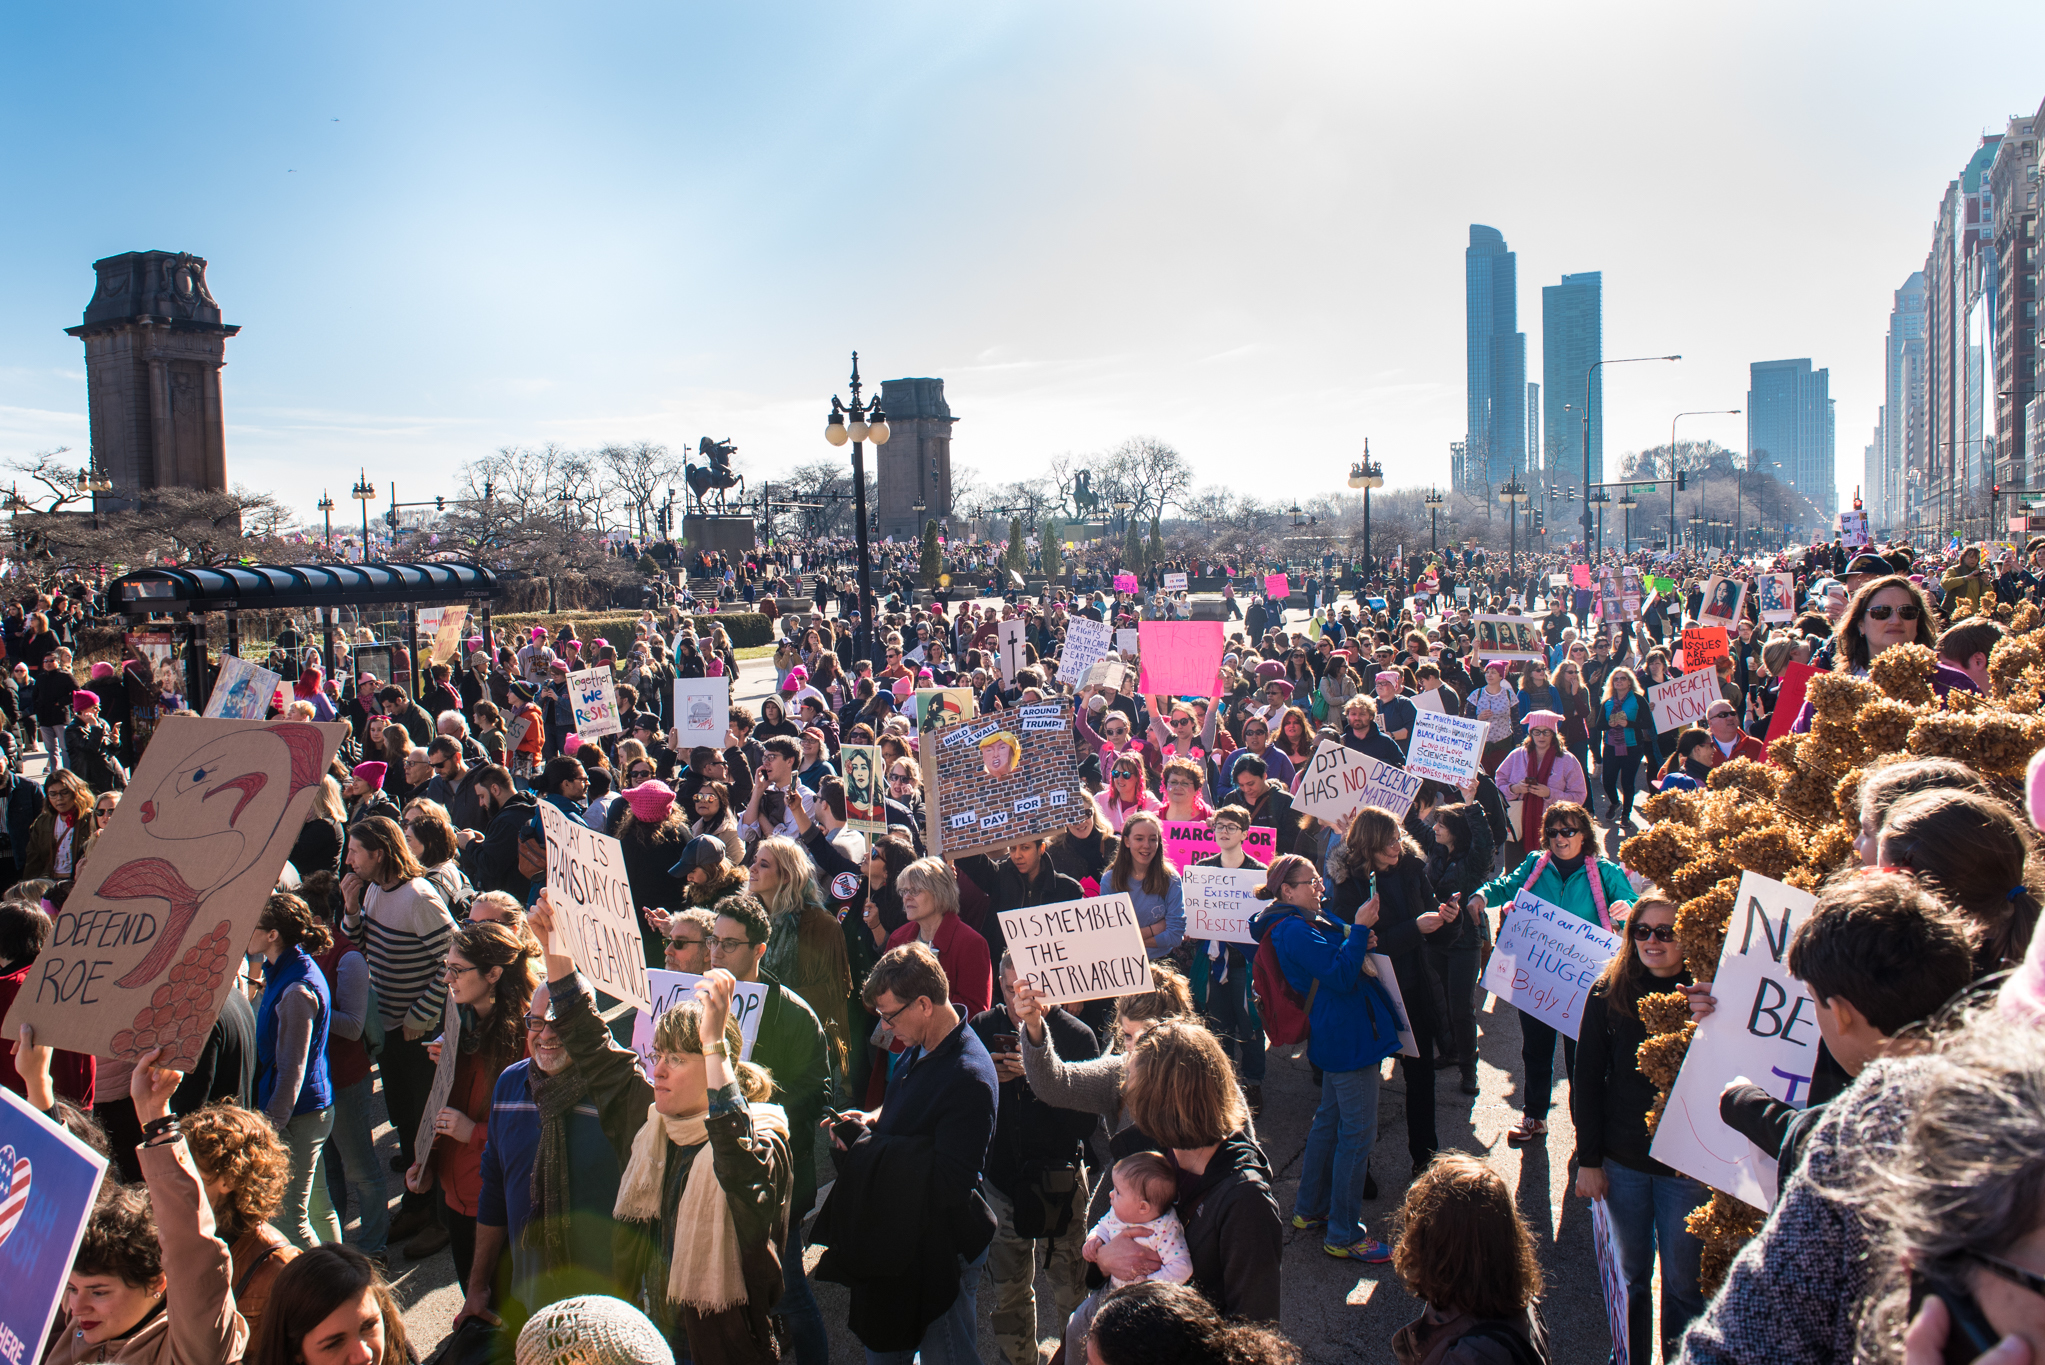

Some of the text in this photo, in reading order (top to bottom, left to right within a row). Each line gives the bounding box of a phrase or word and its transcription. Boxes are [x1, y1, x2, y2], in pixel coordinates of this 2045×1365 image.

[223, 600, 238, 608] cta
[463, 590, 490, 598] JCDecaux
[1076, 626, 1101, 640] RIGHTS
[1086, 620, 1105, 632] GRAB
[1154, 623, 1209, 649] FREE
[1684, 630, 1705, 640] ALL
[1091, 638, 1109, 650] CARE
[1684, 639, 1722, 651] ISSUES
[1686, 650, 1707, 659] ARE
[1070, 651, 1096, 664] EARTH
[566, 671, 611, 691] Together
[1143, 652, 1217, 691] MELANIA
[1657, 671, 1712, 701] IMPEACH
[1022, 707, 1059, 716] AROUND
[1423, 712, 1432, 720] I
[1025, 719, 1062, 729] TRUMP!
[1434, 723, 1448, 734] rights
[944, 724, 997, 746] BUILD A WALL
[1416, 729, 1473, 752] BLACK LIVES MATTER
[1416, 746, 1474, 770] SCIENCE IS REAL
[1421, 739, 1438, 752] Love
[1446, 745, 1463, 758] Love
[1315, 746, 1348, 774] DJT
[1303, 761, 1423, 806] HAS NO DECENCY
[954, 793, 1065, 827] I'LL PAY FOR IT!
[1170, 826, 1217, 842] MARC
[590, 834, 609, 867] IS
[546, 835, 631, 920] TRANS DAY OF
[1184, 870, 1237, 886] RESPECT
[1185, 898, 1242, 910] OR EXPECT
[52, 909, 157, 948] DEFEND
[1004, 901, 1132, 940] DISMEMBER
[1196, 909, 1250, 933] RESISTA
[1542, 910, 1557, 922] at
[1557, 919, 1575, 931] our
[1025, 939, 1068, 966] THE
[1511, 918, 1598, 970] it's Tremendous
[1496, 963, 1506, 974] it's
[1504, 938, 1596, 990] it's HUGE
[36, 957, 113, 1005] ROE
[1025, 954, 1146, 1000] PATRIARCHY
